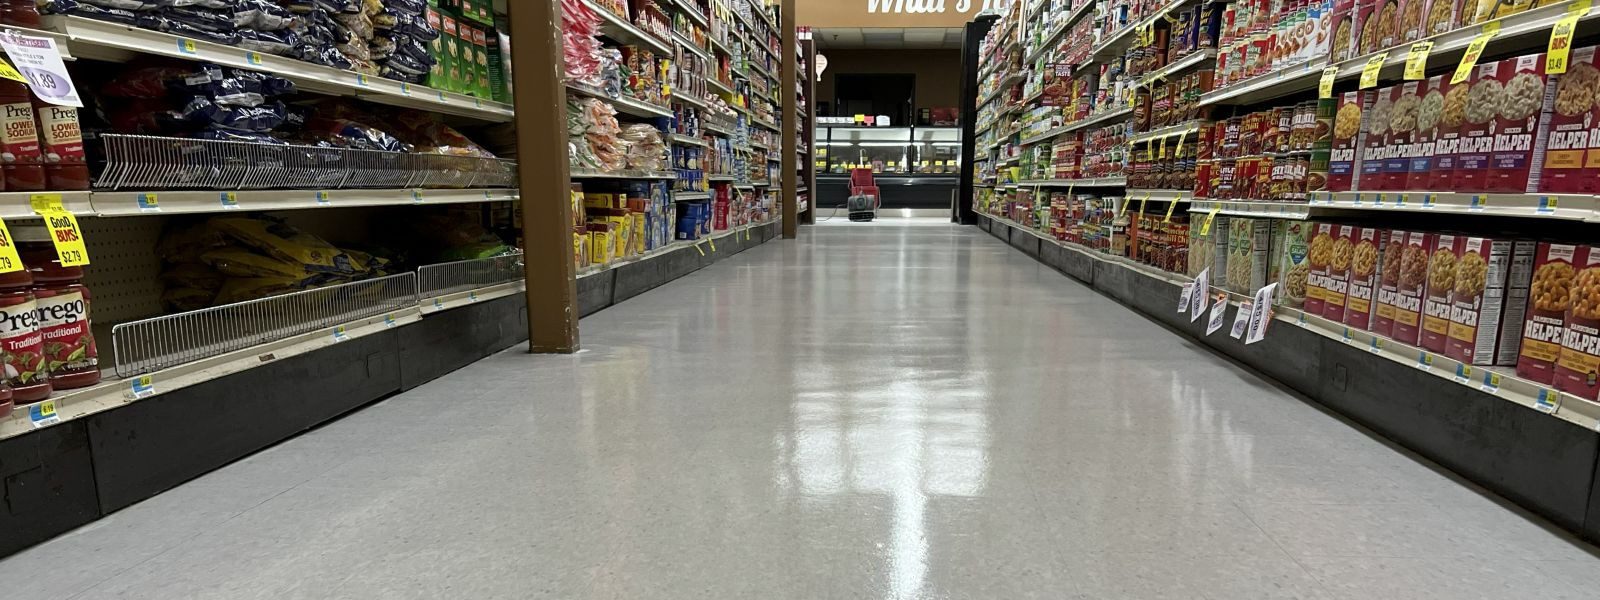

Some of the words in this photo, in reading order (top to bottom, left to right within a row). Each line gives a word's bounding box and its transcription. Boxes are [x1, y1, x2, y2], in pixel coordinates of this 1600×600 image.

[867, 0, 972, 13] Whats
[25, 69, 57, 88] $1.89
[6, 105, 33, 119] Preg
[51, 107, 78, 121] Preg
[1435, 139, 1460, 154] HELPE
[1459, 137, 1493, 153] HELPER
[1493, 134, 1532, 151] HELPER
[1548, 131, 1589, 149] HELPER
[1330, 149, 1354, 161] HELPER
[1385, 144, 1412, 158] HELPER
[50, 216, 71, 228] GOOD
[55, 223, 79, 242] BUYS!
[61, 250, 82, 263] $2.79
[1350, 283, 1371, 300] HELPER
[1396, 293, 1421, 312] HELPER
[1425, 299, 1451, 319] HELPER
[37, 299, 84, 324] rego
[1450, 304, 1477, 326] HELPER
[43, 325, 82, 340] raditional
[1524, 320, 1562, 343] HELPE
